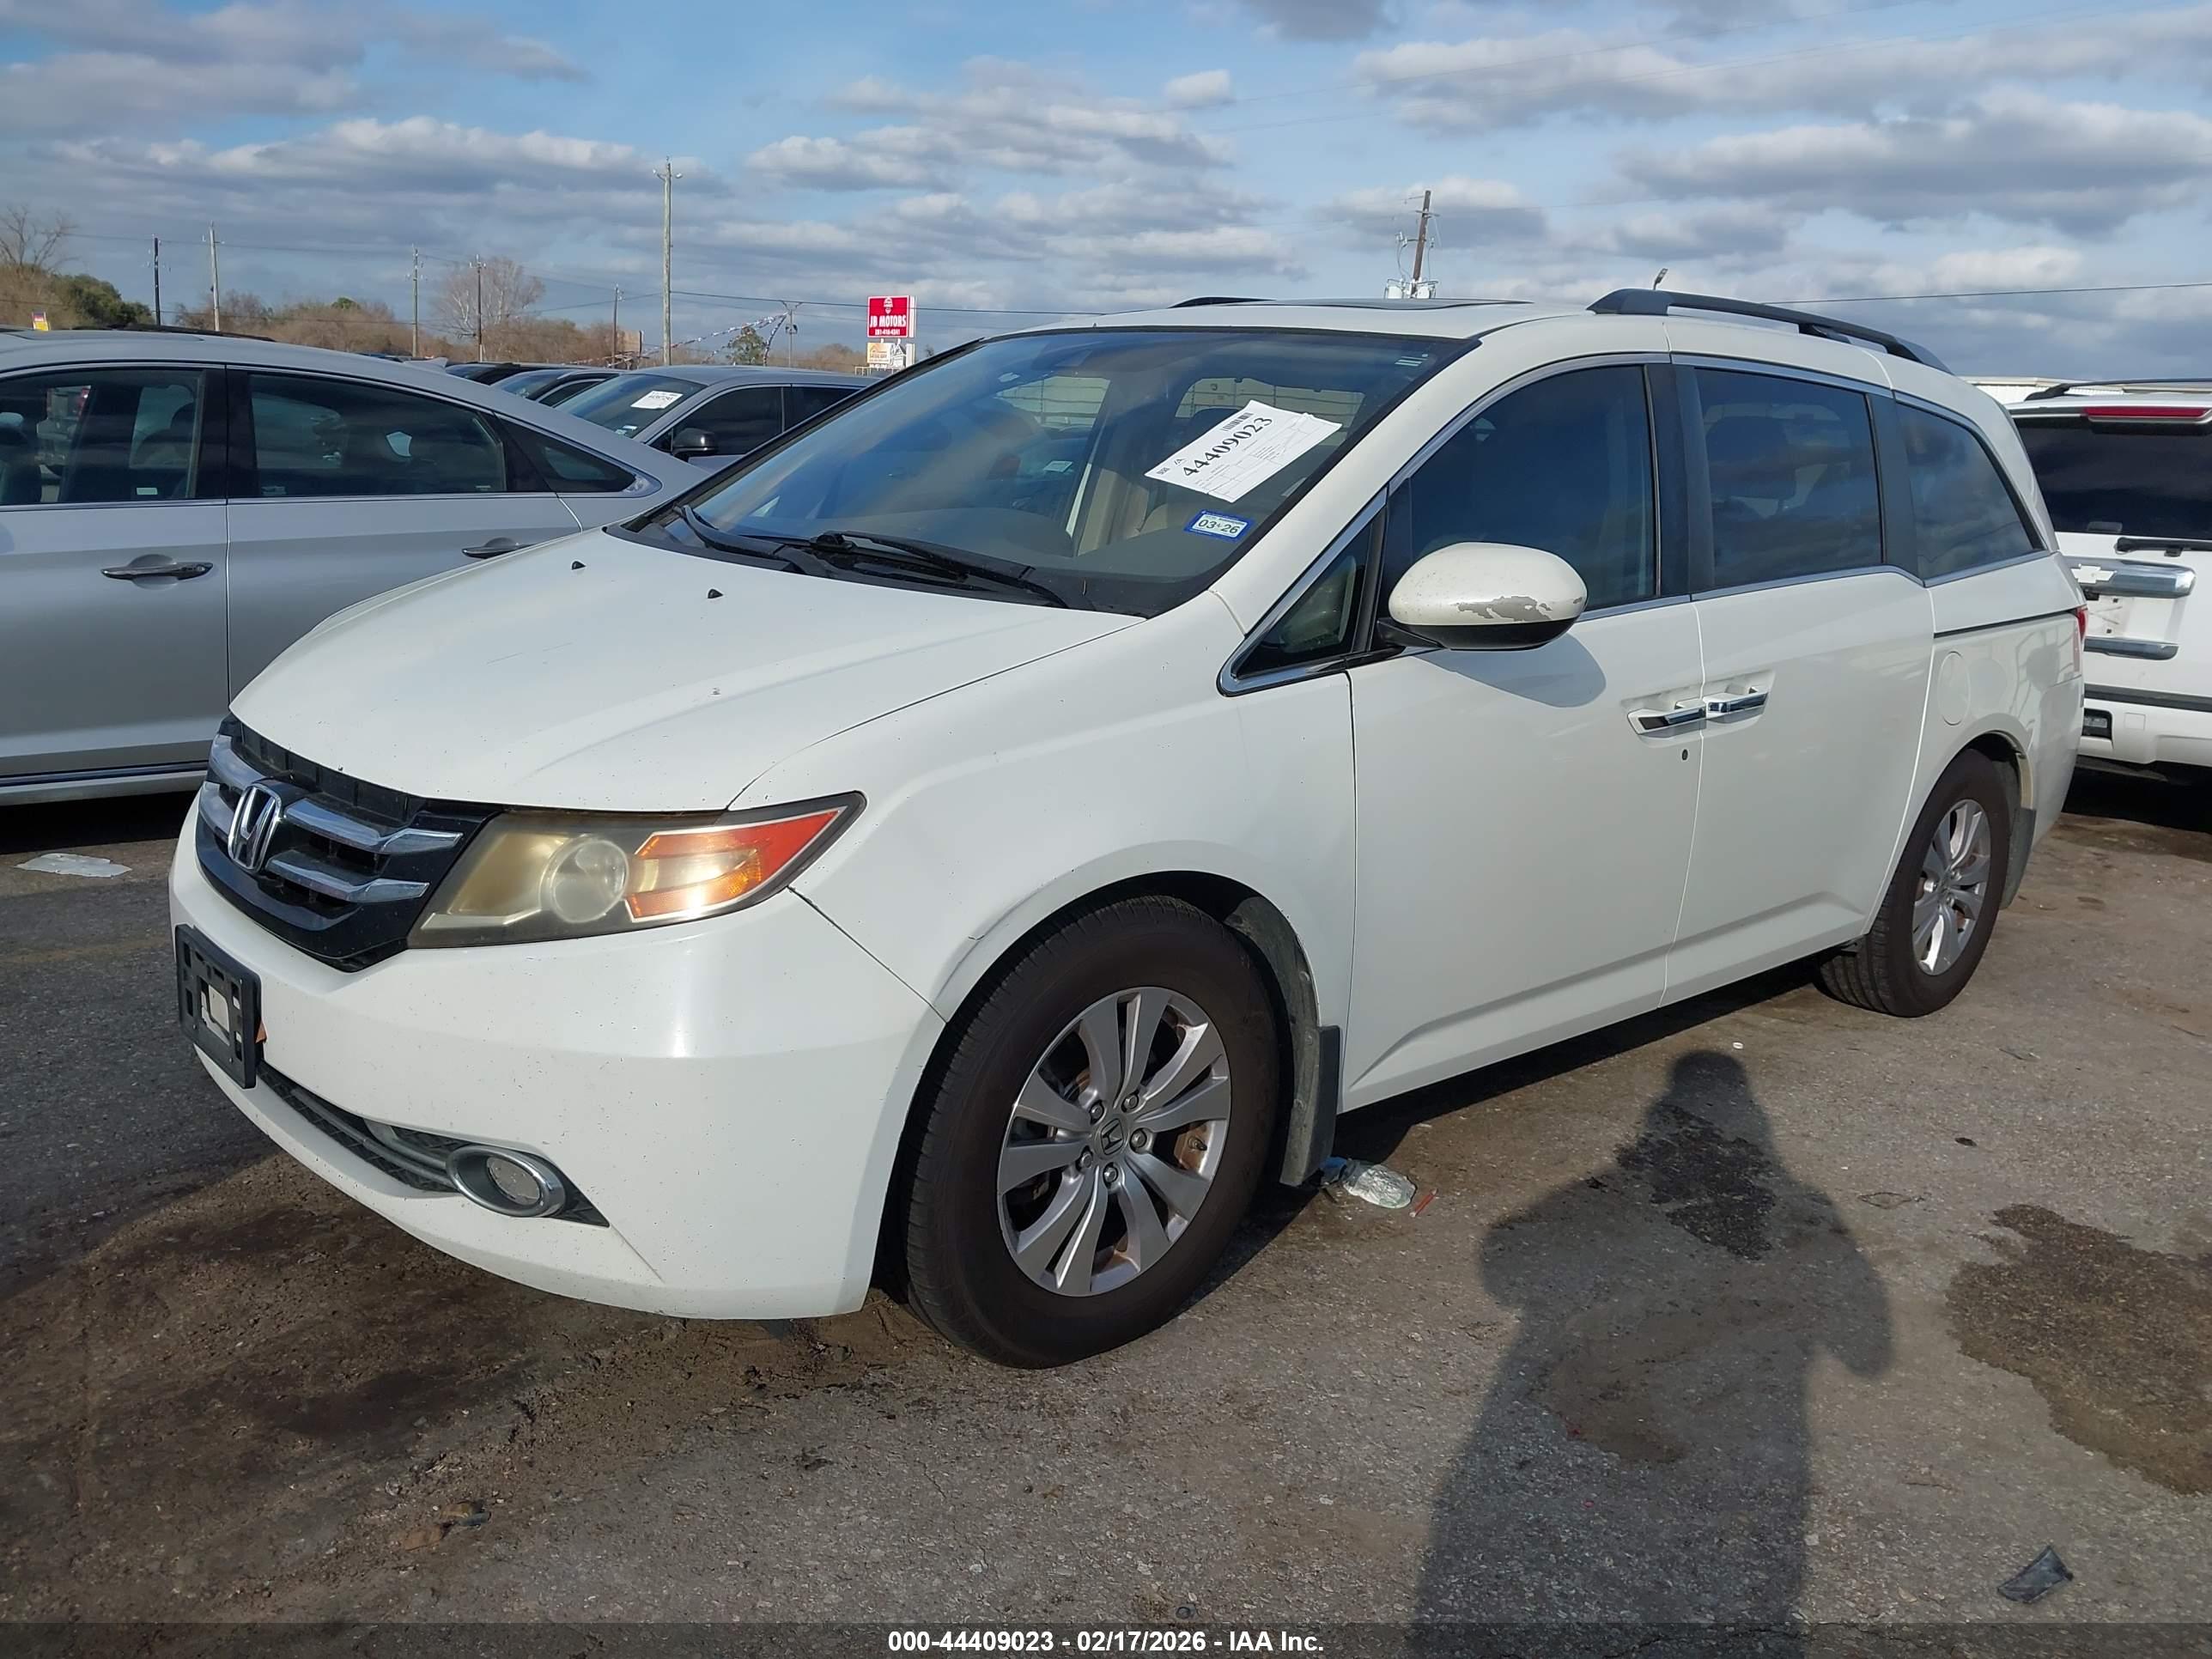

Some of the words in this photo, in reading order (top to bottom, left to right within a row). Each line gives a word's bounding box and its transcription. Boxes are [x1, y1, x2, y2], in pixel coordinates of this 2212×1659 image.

[879, 315, 906, 327] MOTORS
[1183, 416, 1273, 477] 44409023
[1198, 519, 1218, 529] 03
[1220, 524, 1241, 534] 26
